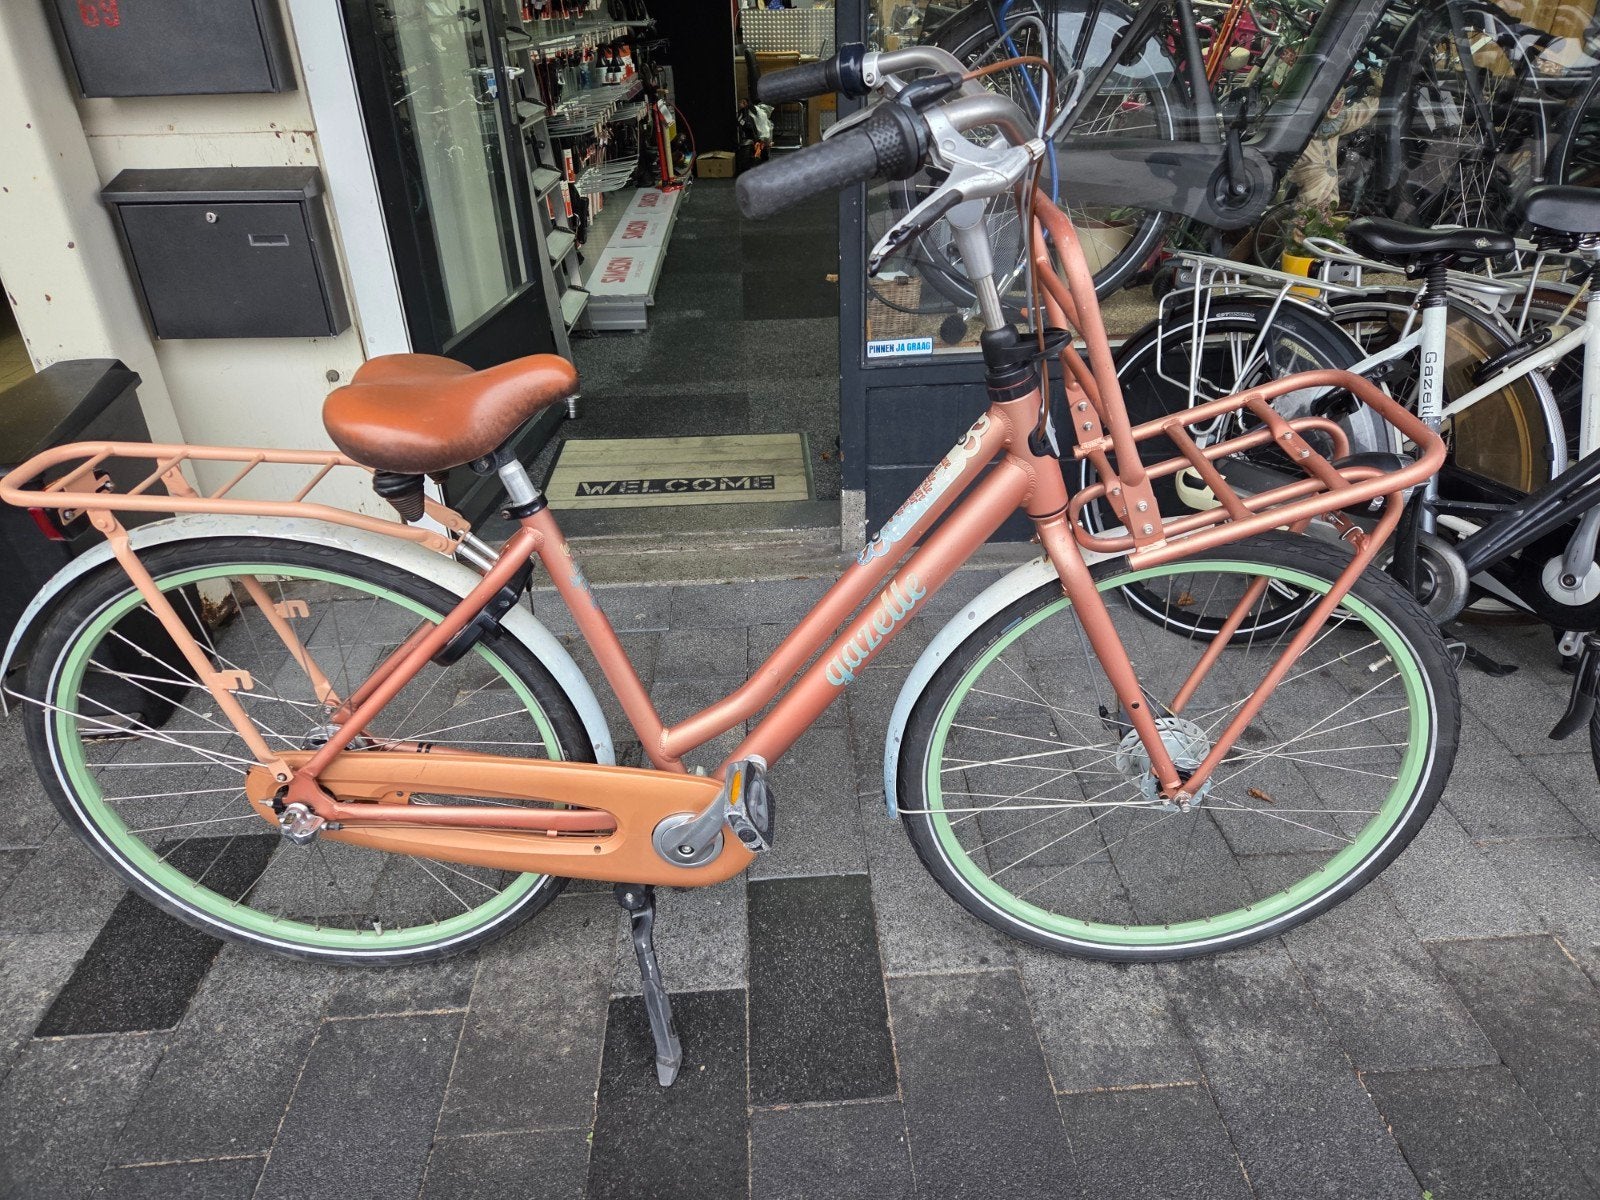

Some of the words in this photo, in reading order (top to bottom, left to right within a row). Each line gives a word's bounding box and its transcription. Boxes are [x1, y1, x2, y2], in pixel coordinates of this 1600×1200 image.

[76, 0, 120, 27] 69
[621, 220, 649, 239] SIMSON
[600, 256, 634, 284] SIMSON
[869, 344, 895, 353] PINNEN
[896, 343, 905, 352] JA
[907, 341, 931, 351] GRAAG
[580, 476, 775, 496] WELCOME
